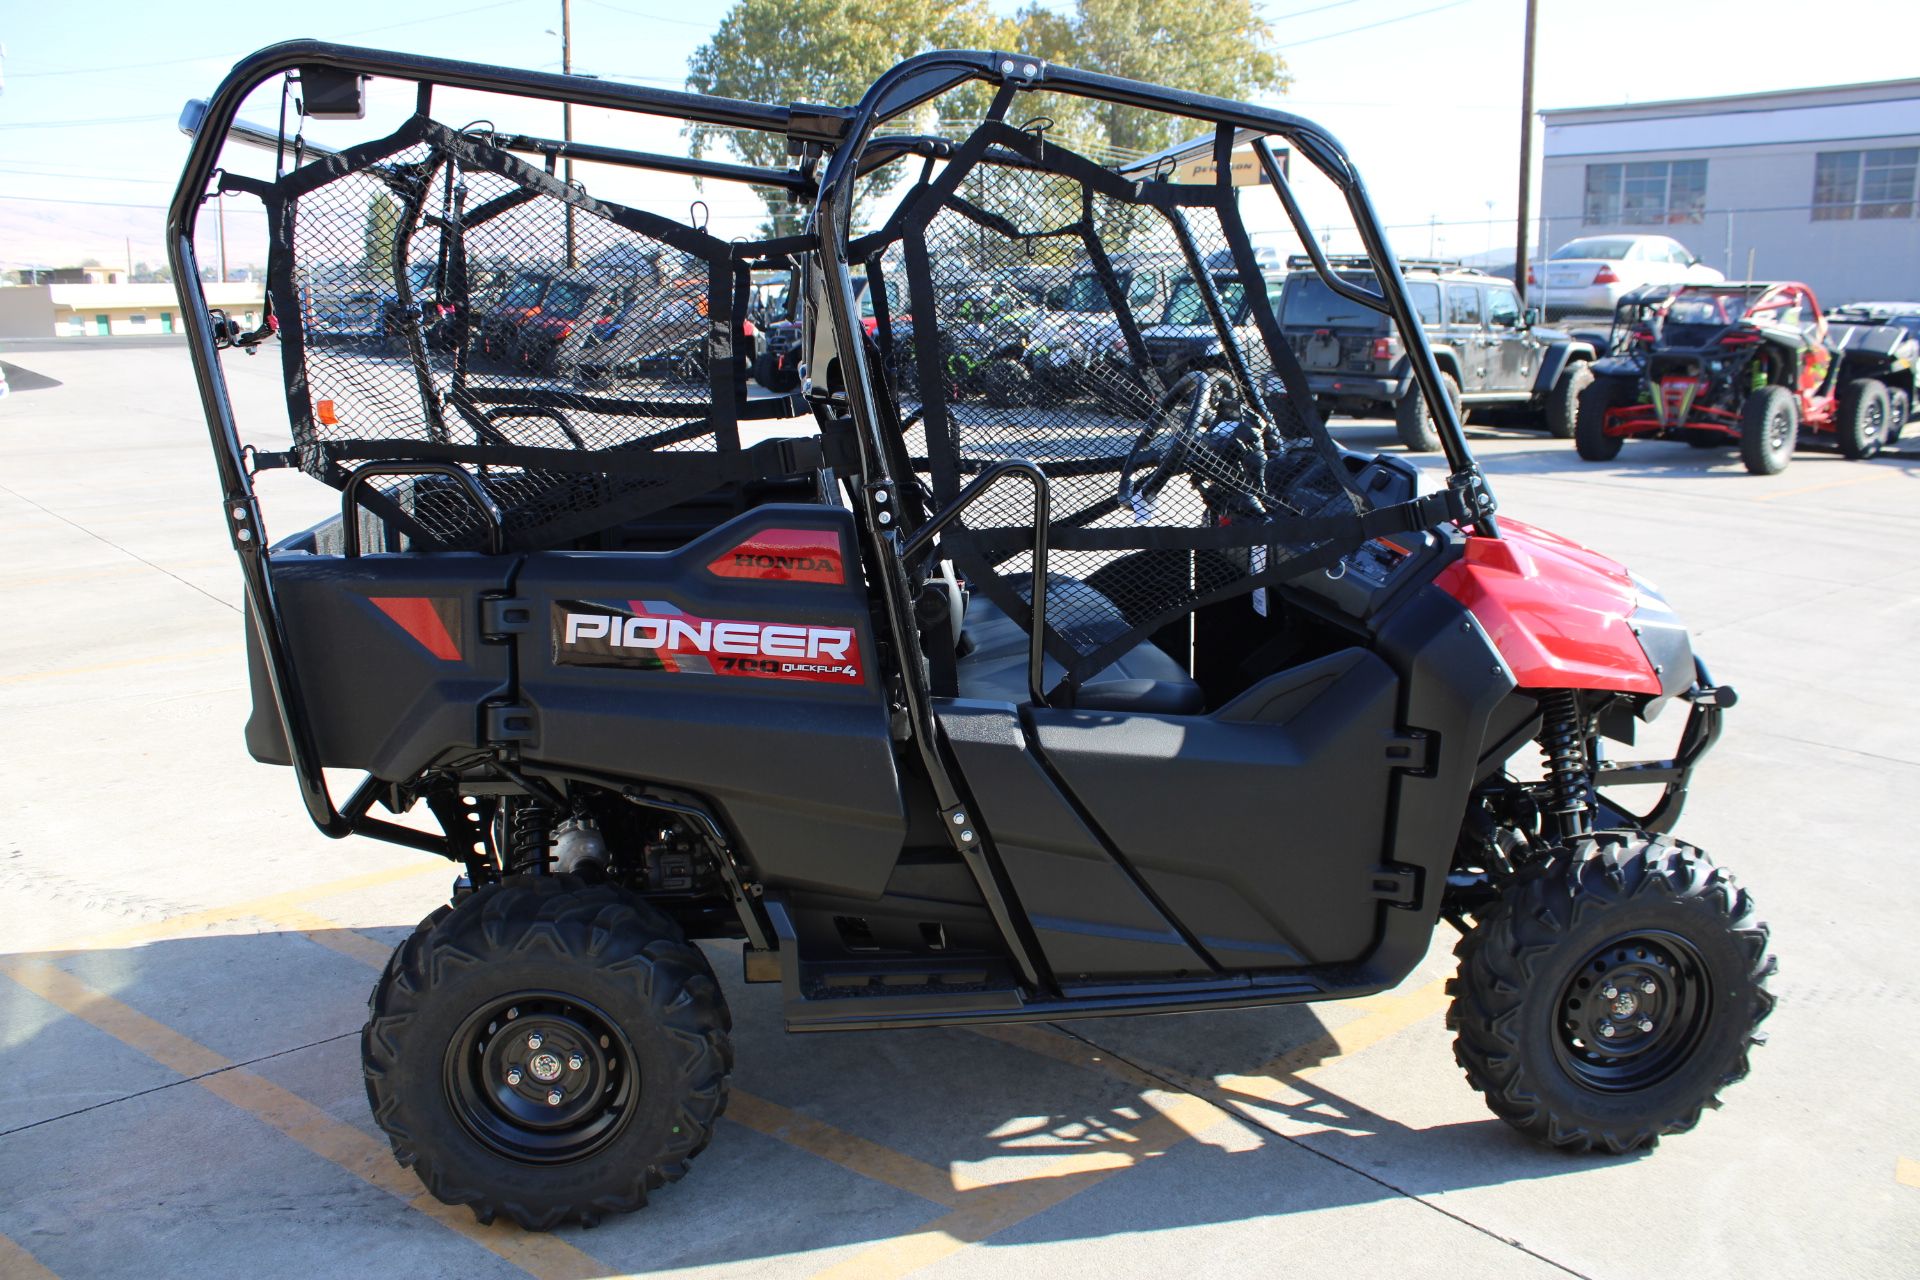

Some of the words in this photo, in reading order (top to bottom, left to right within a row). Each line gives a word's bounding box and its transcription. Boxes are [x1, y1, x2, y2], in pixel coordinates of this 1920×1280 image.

[734, 553, 835, 572] HONDA
[565, 613, 852, 660] PIONEER
[717, 657, 780, 673] 700
